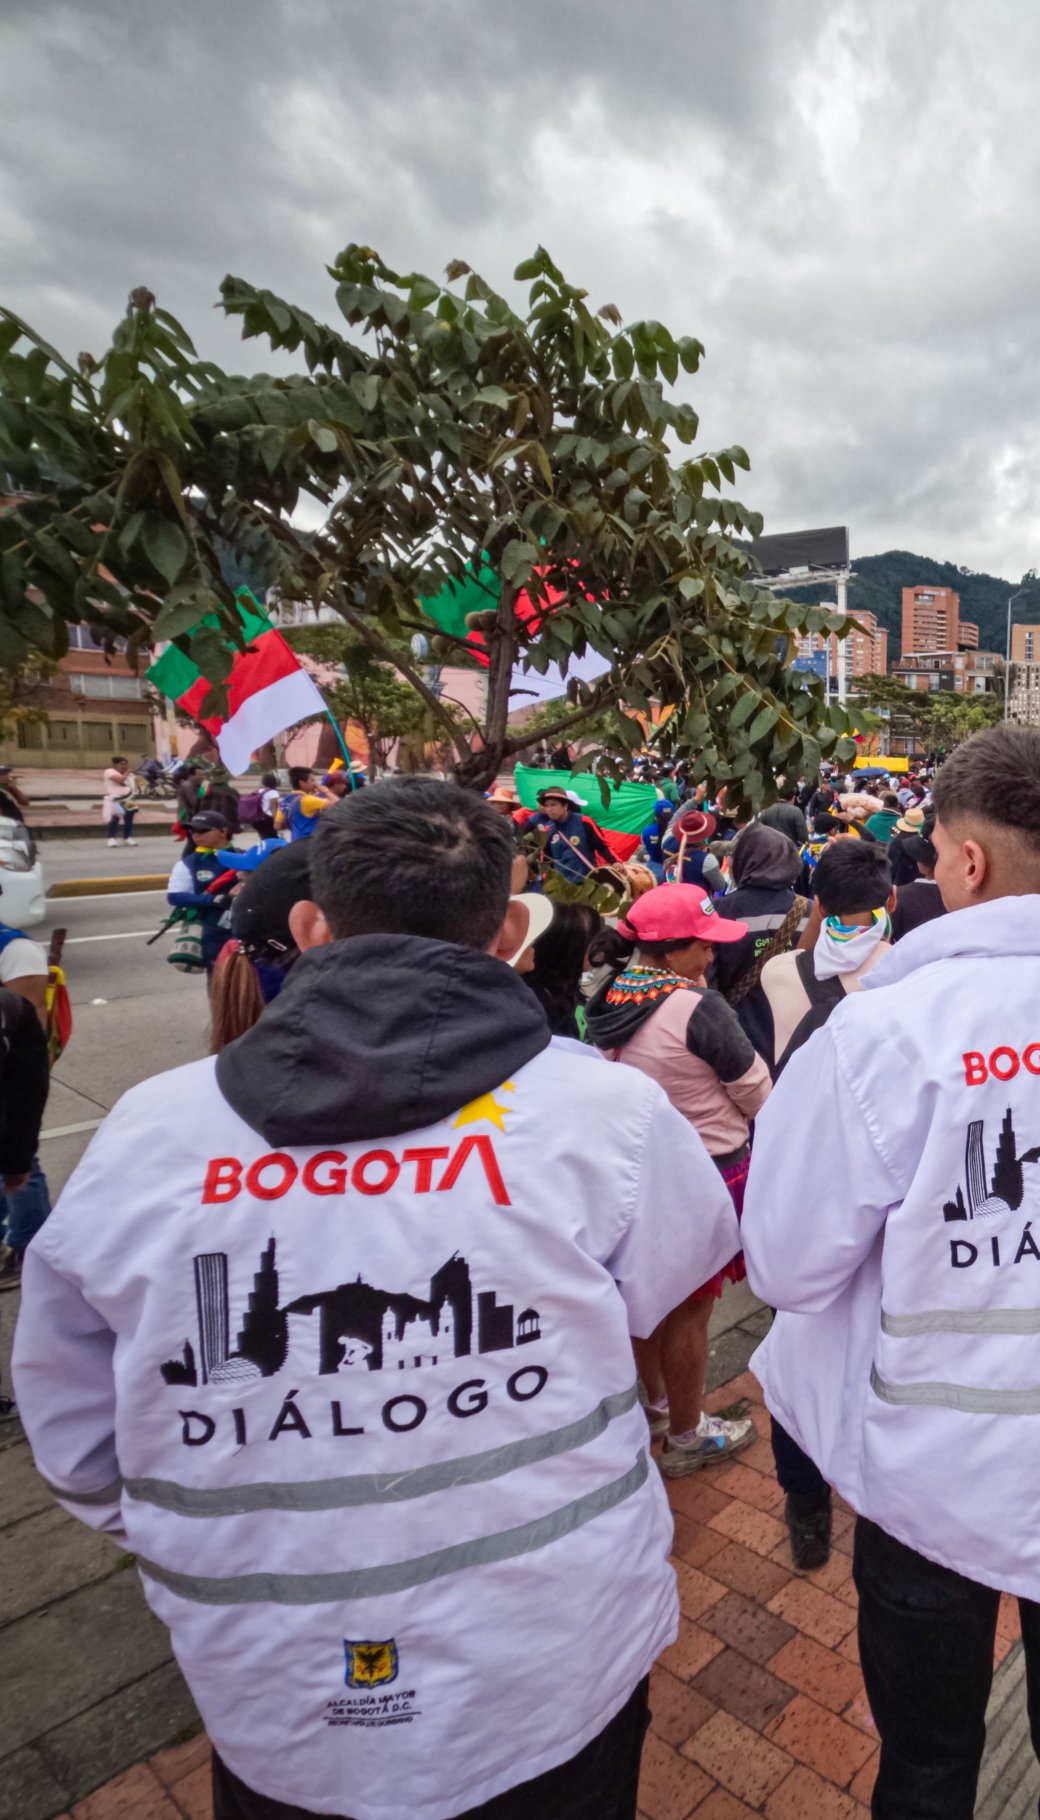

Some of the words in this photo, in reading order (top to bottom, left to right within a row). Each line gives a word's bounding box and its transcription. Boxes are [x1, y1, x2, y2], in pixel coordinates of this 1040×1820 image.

[178, 1365, 548, 1446] DIÁLOGO
[327, 1696, 375, 1708] ALCALDÍA
[379, 1690, 415, 1703] MAYOR
[332, 1707, 344, 1715] DE
[346, 1703, 388, 1715] BOGOTÁ
